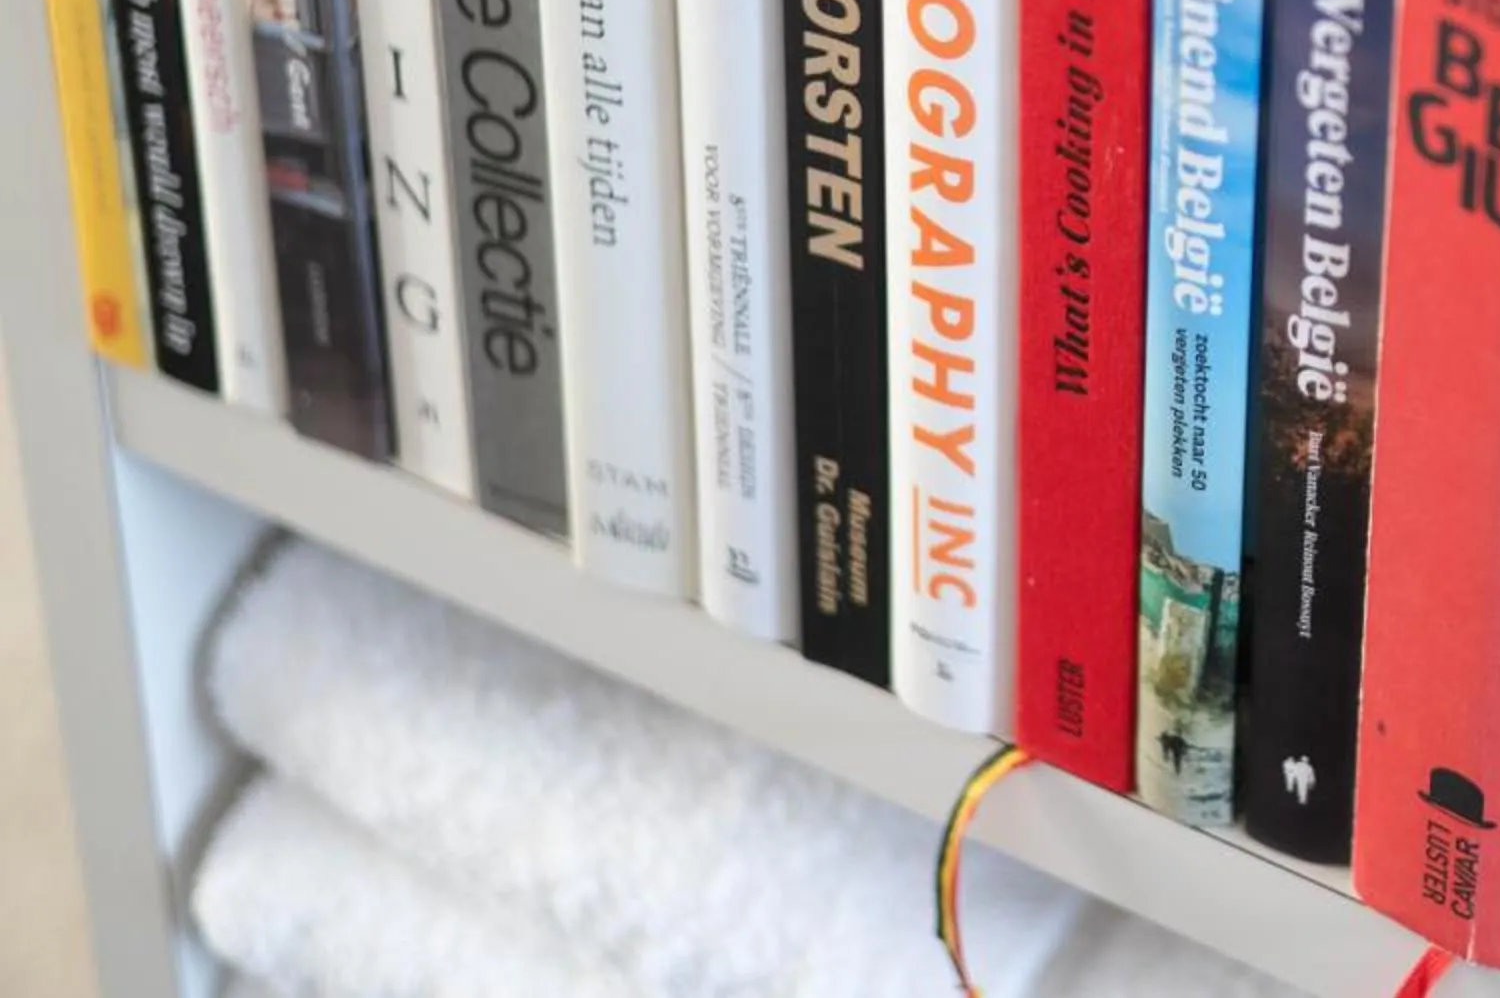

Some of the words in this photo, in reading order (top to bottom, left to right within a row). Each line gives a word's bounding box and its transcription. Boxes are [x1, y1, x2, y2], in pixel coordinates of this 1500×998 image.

[1057, 9, 1094, 58] in
[582, 52, 623, 126] alle
[578, 137, 629, 249] tijden
[1055, 65, 1104, 245] Cooking
[461, 49, 554, 377] Collectie
[1163, 144, 1226, 316] België
[1054, 252, 1090, 396] What's
[1287, 234, 1353, 402] België
[1169, 328, 1188, 405] vergeten
[1191, 334, 1211, 421] zoektocht
[815, 453, 841, 495] Dr.
[1170, 406, 1188, 479] plekken
[1190, 469, 1207, 491] 50
[1191, 422, 1206, 468] naar
[847, 487, 873, 607] Museum
[926, 500, 977, 609] INC
[1423, 819, 1453, 905] LUSTER
